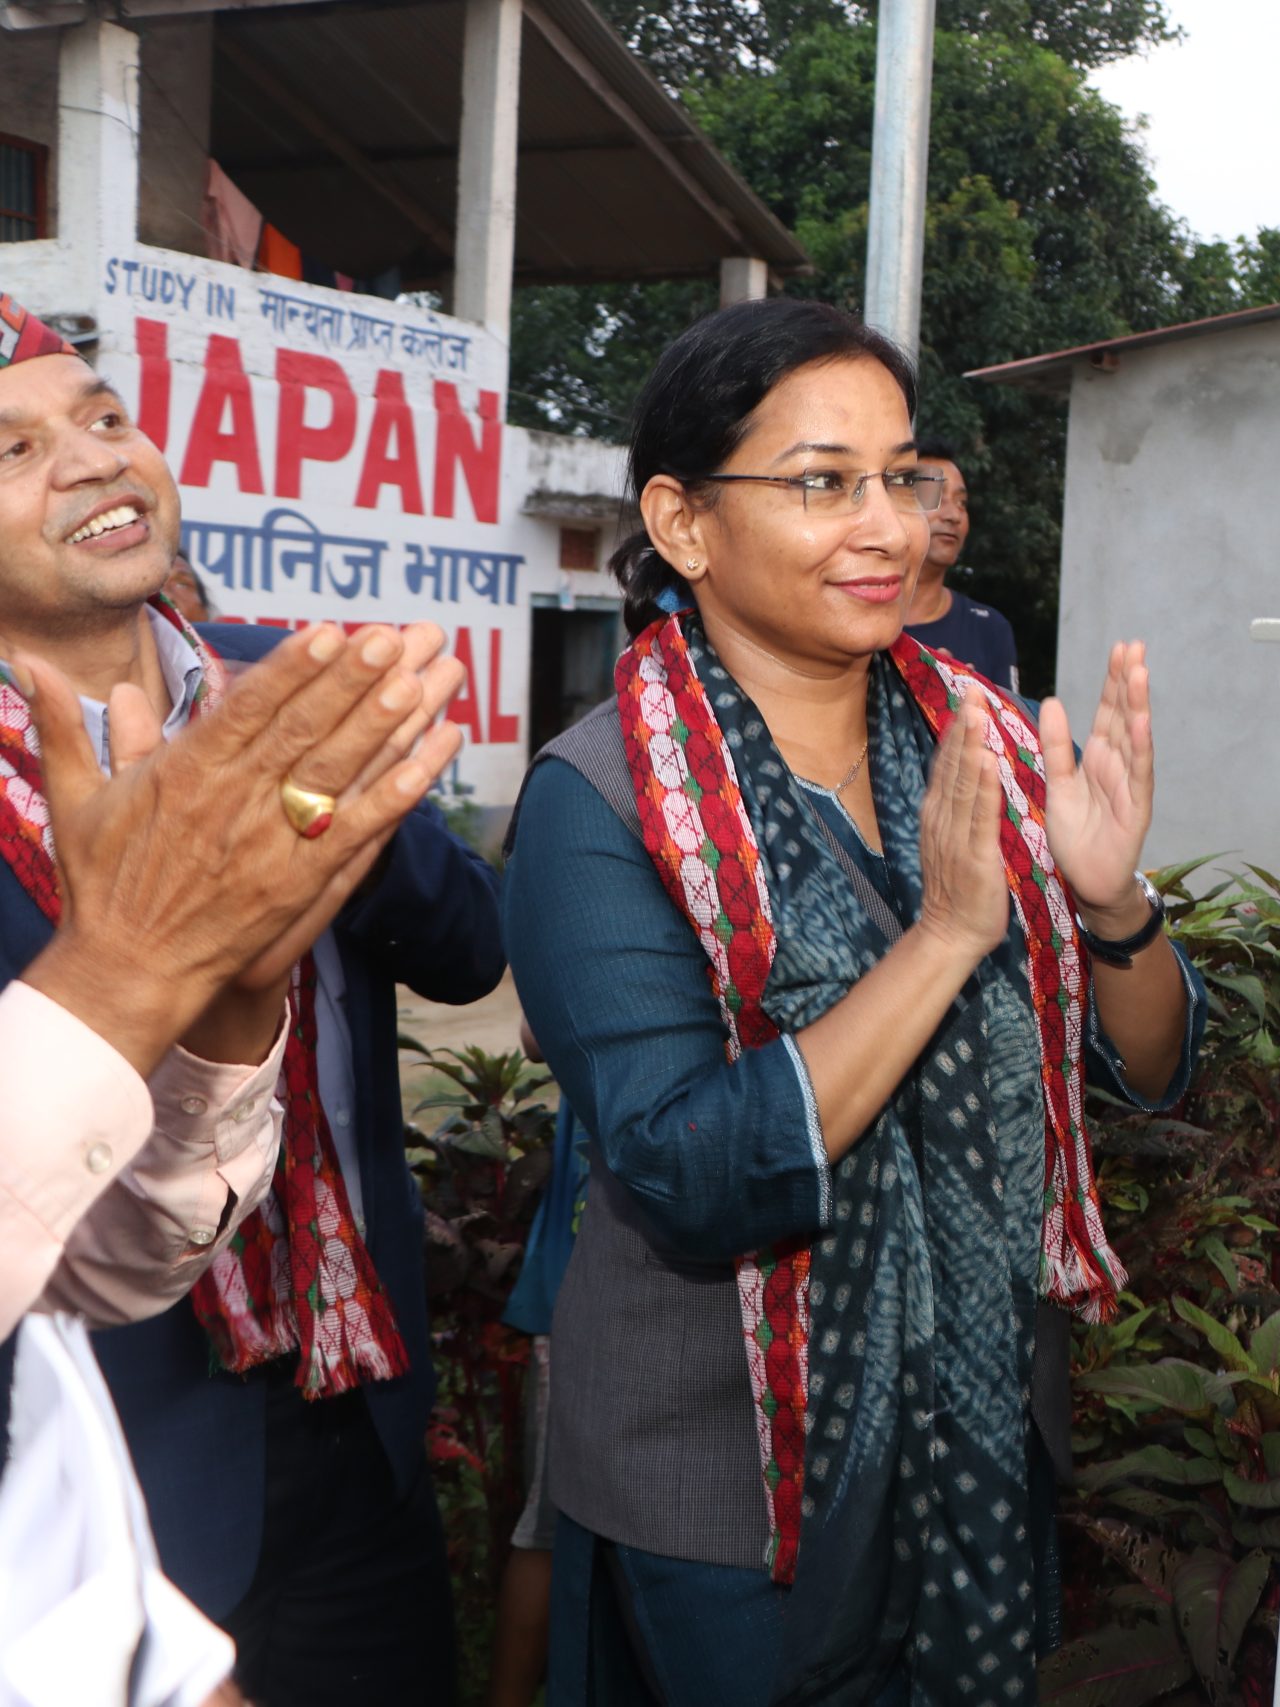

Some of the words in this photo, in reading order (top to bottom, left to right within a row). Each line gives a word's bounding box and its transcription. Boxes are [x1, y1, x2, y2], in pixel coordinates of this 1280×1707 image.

[105, 257, 196, 310] STUDY
[207, 282, 236, 320] IN
[258, 289, 346, 351] मान्यता
[348, 311, 395, 355] प्राप्त
[401, 313, 472, 371] कलेज
[136, 316, 502, 524] JAPAN
[404, 543, 525, 606] भाषा
